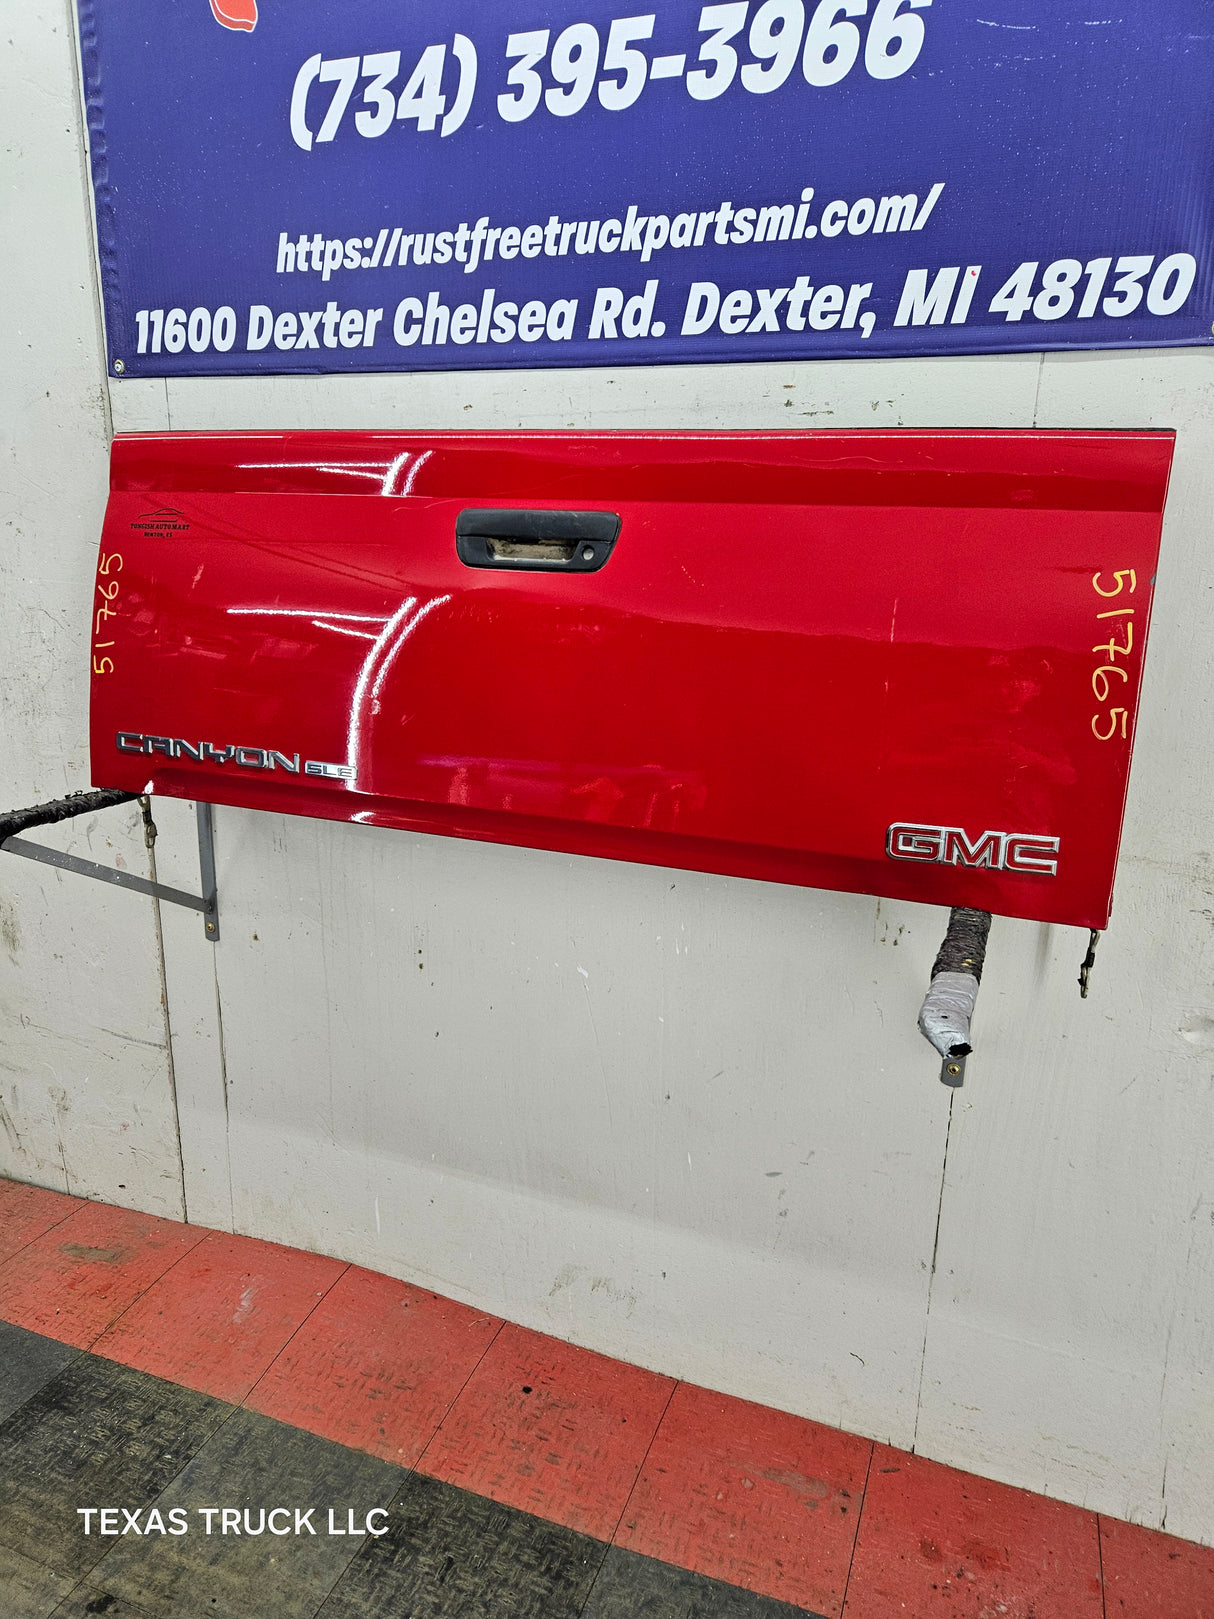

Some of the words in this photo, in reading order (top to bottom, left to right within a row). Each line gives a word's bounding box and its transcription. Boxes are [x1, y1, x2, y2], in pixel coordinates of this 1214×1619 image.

[290, 34, 478, 152] (734)
[497, 0, 932, 123] 395-3966
[277, 183, 945, 282] https://rustfreetruckpartsmi.com/
[135, 306, 237, 354] 11600
[246, 302, 384, 351] Dexter
[394, 289, 579, 347] Chelsea
[587, 280, 666, 340] Rd.
[680, 276, 876, 339] Dexter,
[893, 265, 983, 327] MI
[988, 252, 1197, 322] 48130
[93, 553, 123, 674] 51765
[1092, 568, 1137, 741] 51765
[116, 731, 300, 774] CANYON
[305, 760, 358, 781] SLE
[885, 821, 1060, 877] GMC
